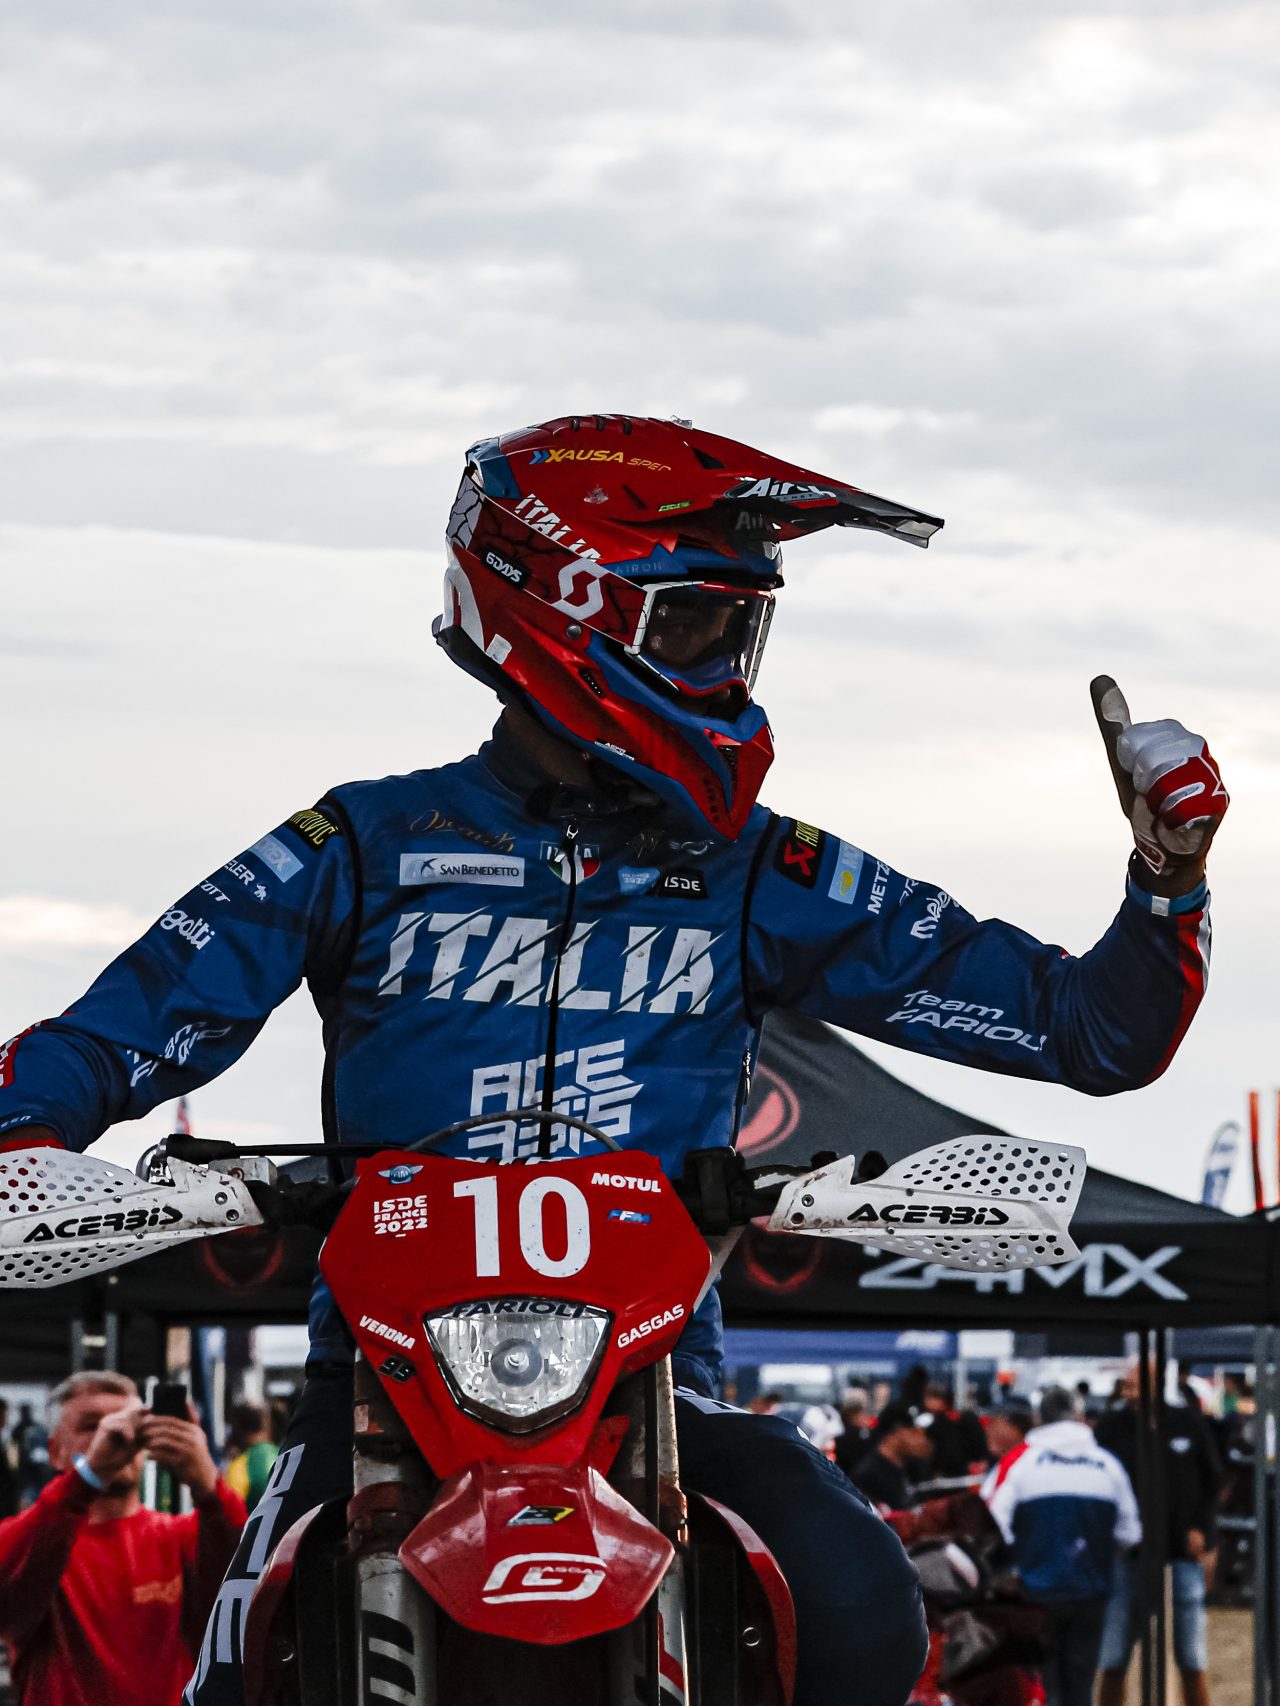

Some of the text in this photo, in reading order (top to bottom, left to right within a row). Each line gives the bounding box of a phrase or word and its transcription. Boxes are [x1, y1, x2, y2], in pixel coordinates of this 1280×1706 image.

[739, 477, 837, 499] Airh
[485, 550, 524, 584] 6DAYS
[664, 876, 701, 892] ISDE
[376, 904, 728, 1016] ITALIA
[904, 990, 1004, 1020] Team
[591, 1172, 662, 1193] MOTUL
[373, 1195, 428, 1214] ISDE
[374, 1208, 428, 1223] FRANCE
[846, 1203, 1009, 1225] ACERBIS
[23, 1205, 184, 1243] ACERBIS
[374, 1217, 428, 1235] 2022
[453, 1175, 592, 1278] 10
[452, 1300, 588, 1319] FARIOLI
[358, 1314, 416, 1350] VERONA
[617, 1304, 685, 1349] GASGAS
